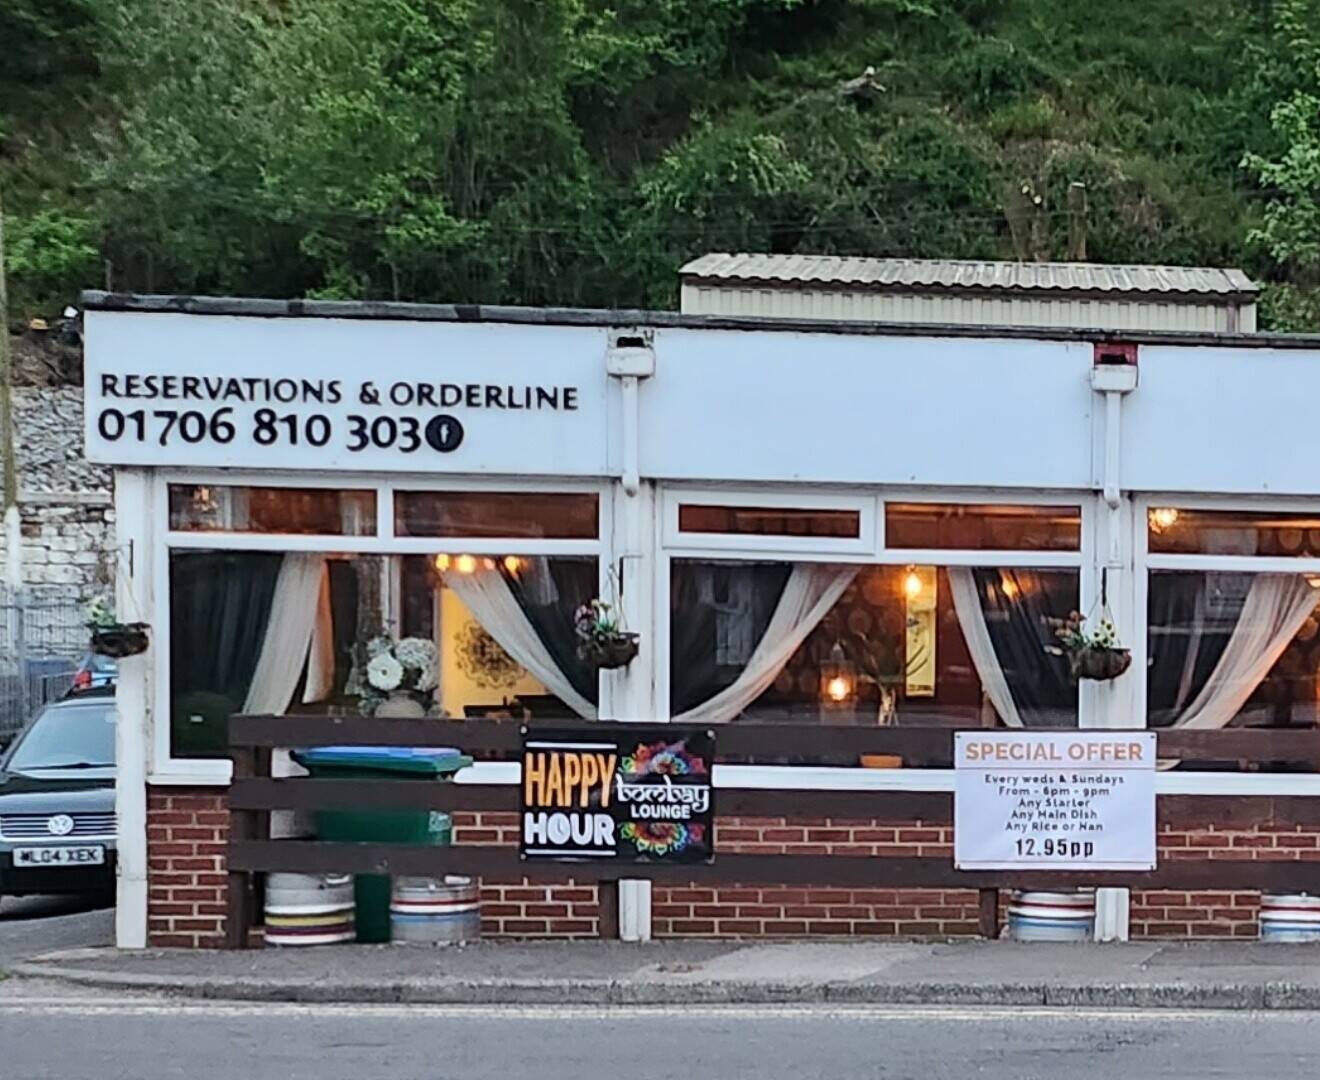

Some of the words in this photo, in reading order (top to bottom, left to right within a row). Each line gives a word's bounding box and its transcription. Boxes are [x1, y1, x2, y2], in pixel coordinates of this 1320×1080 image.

[100, 374, 342, 404] RESERVATIONS
[359, 382, 382, 406] &
[390, 382, 578, 409] ORDERLINE
[98, 408, 236, 446] 01706
[253, 408, 331, 447] 810
[347, 414, 421, 452] 303
[966, 743, 1062, 760] SPECIAL
[1068, 743, 1142, 760] OFFER
[525, 752, 617, 808] HAPPY
[985, 774, 1018, 786] Every
[1023, 774, 1054, 783] weds
[1059, 775, 1066, 783] &
[1072, 774, 1124, 786] Sundays
[616, 774, 710, 813] bombay
[999, 787, 1030, 795] From
[1043, 786, 1070, 796] 6pm
[1083, 788, 1109, 797] 9pm
[631, 804, 691, 819] LOUNGE
[1018, 798, 1041, 809] Any
[1046, 798, 1090, 807] Starter
[1011, 810, 1033, 821] Any
[1038, 810, 1067, 819] Main
[1071, 810, 1097, 819] Dish
[524, 812, 616, 846] HOUR
[1005, 822, 1027, 833] Any
[1032, 822, 1058, 831] Rice
[1079, 822, 1103, 831] Nan
[1016, 838, 1094, 858] 12.95pp
